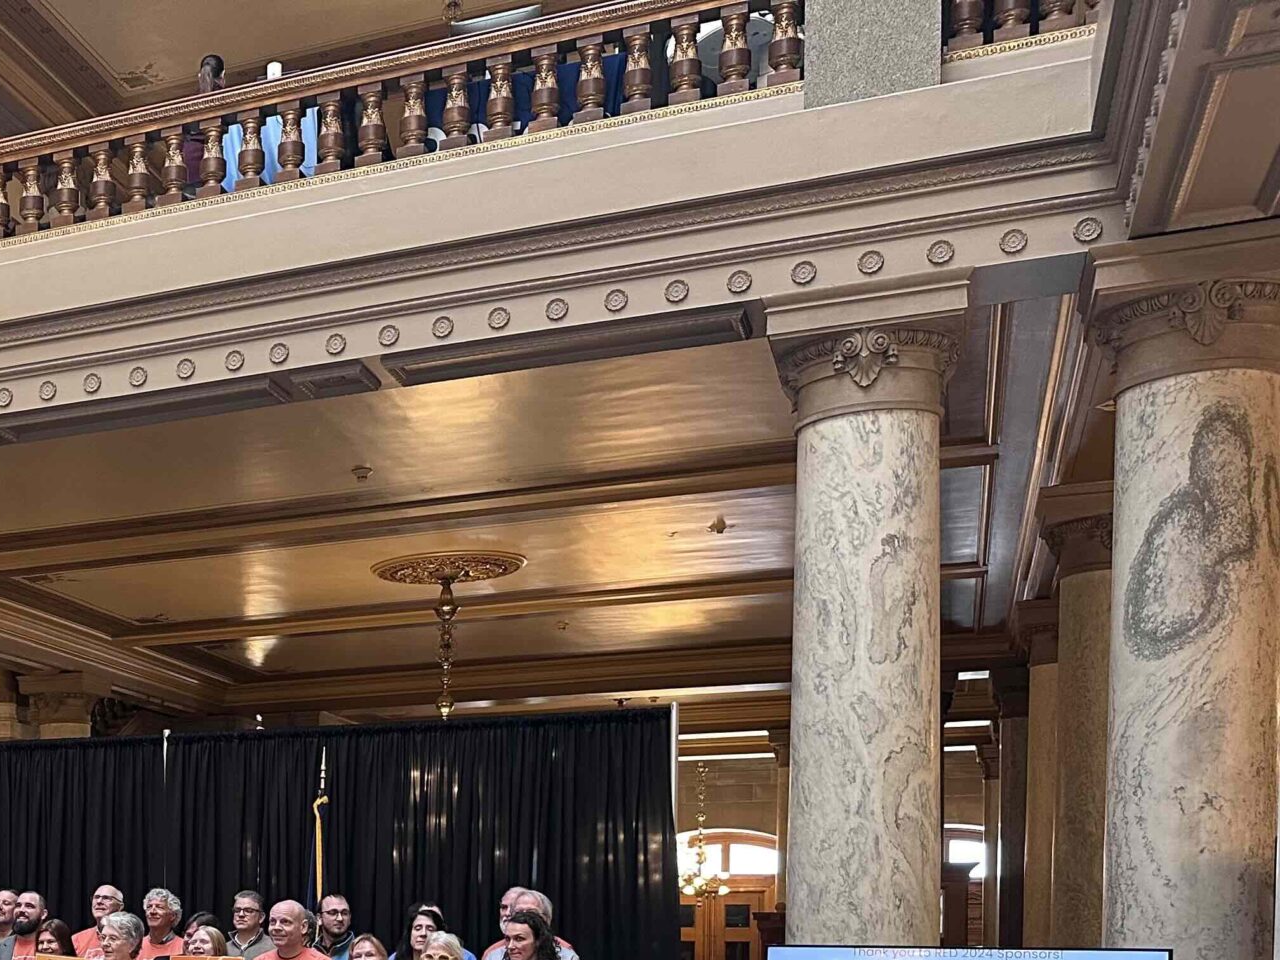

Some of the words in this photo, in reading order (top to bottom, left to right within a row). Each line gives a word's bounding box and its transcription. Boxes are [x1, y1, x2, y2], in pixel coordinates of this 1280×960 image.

[853, 948, 888, 957] Thank
[892, 949, 915, 959] you
[919, 949, 931, 958] to
[935, 949, 958, 958] RED
[962, 949, 993, 959] 2024
[997, 949, 1064, 960] Sponsors!
